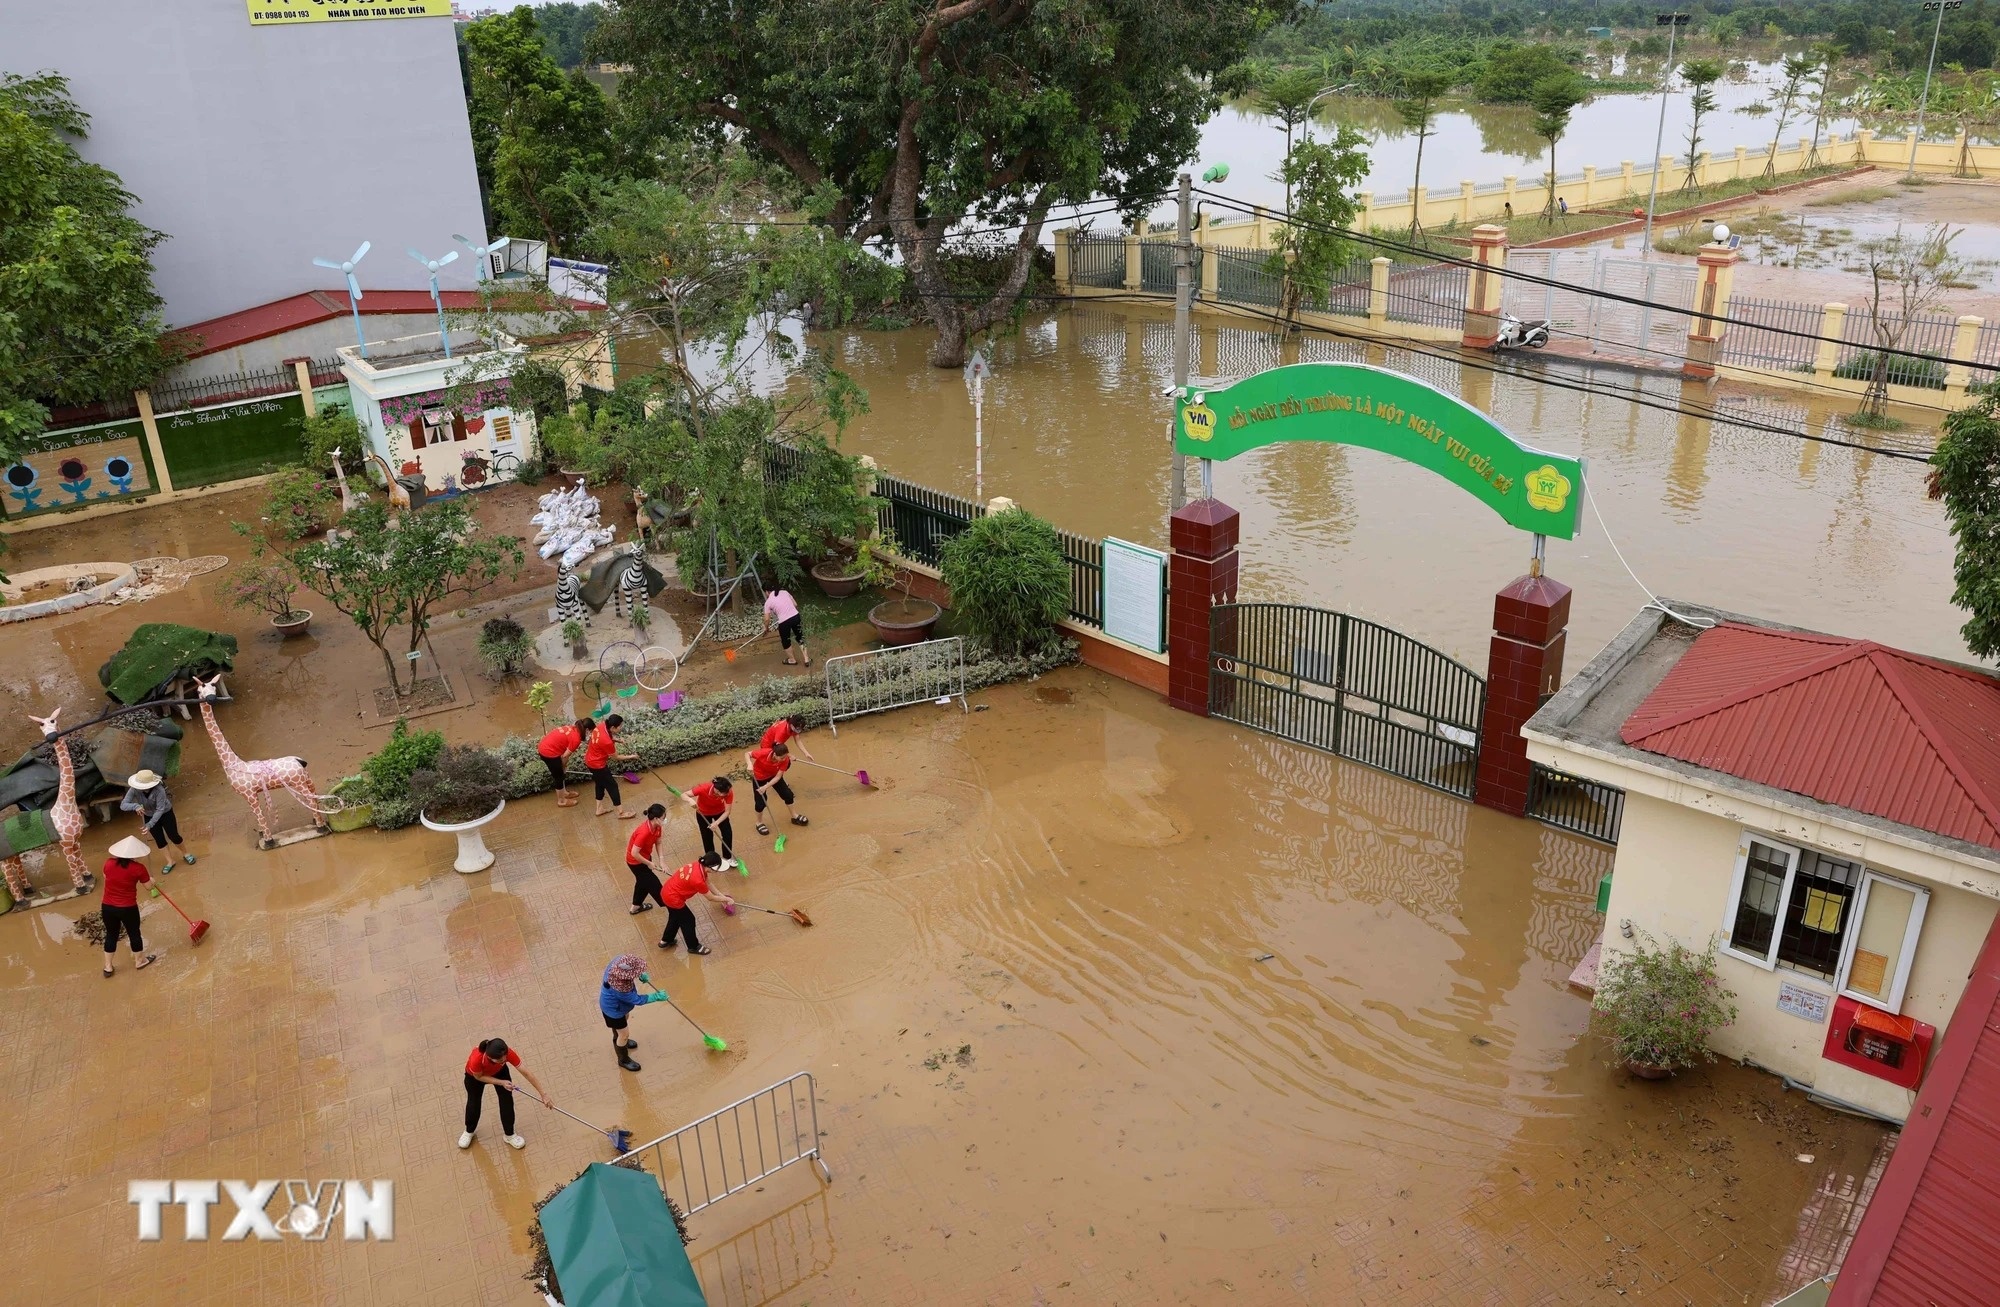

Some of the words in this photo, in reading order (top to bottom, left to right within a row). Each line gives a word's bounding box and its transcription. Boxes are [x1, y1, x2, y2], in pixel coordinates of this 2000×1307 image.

[265, 11, 283, 19] 0988
[1355, 395, 1373, 415] LÀ
[1376, 401, 1405, 426] MỘT
[1407, 413, 1446, 444] NGÀY
[1445, 436, 1471, 462] VUI
[1468, 456, 1495, 482] CỦA
